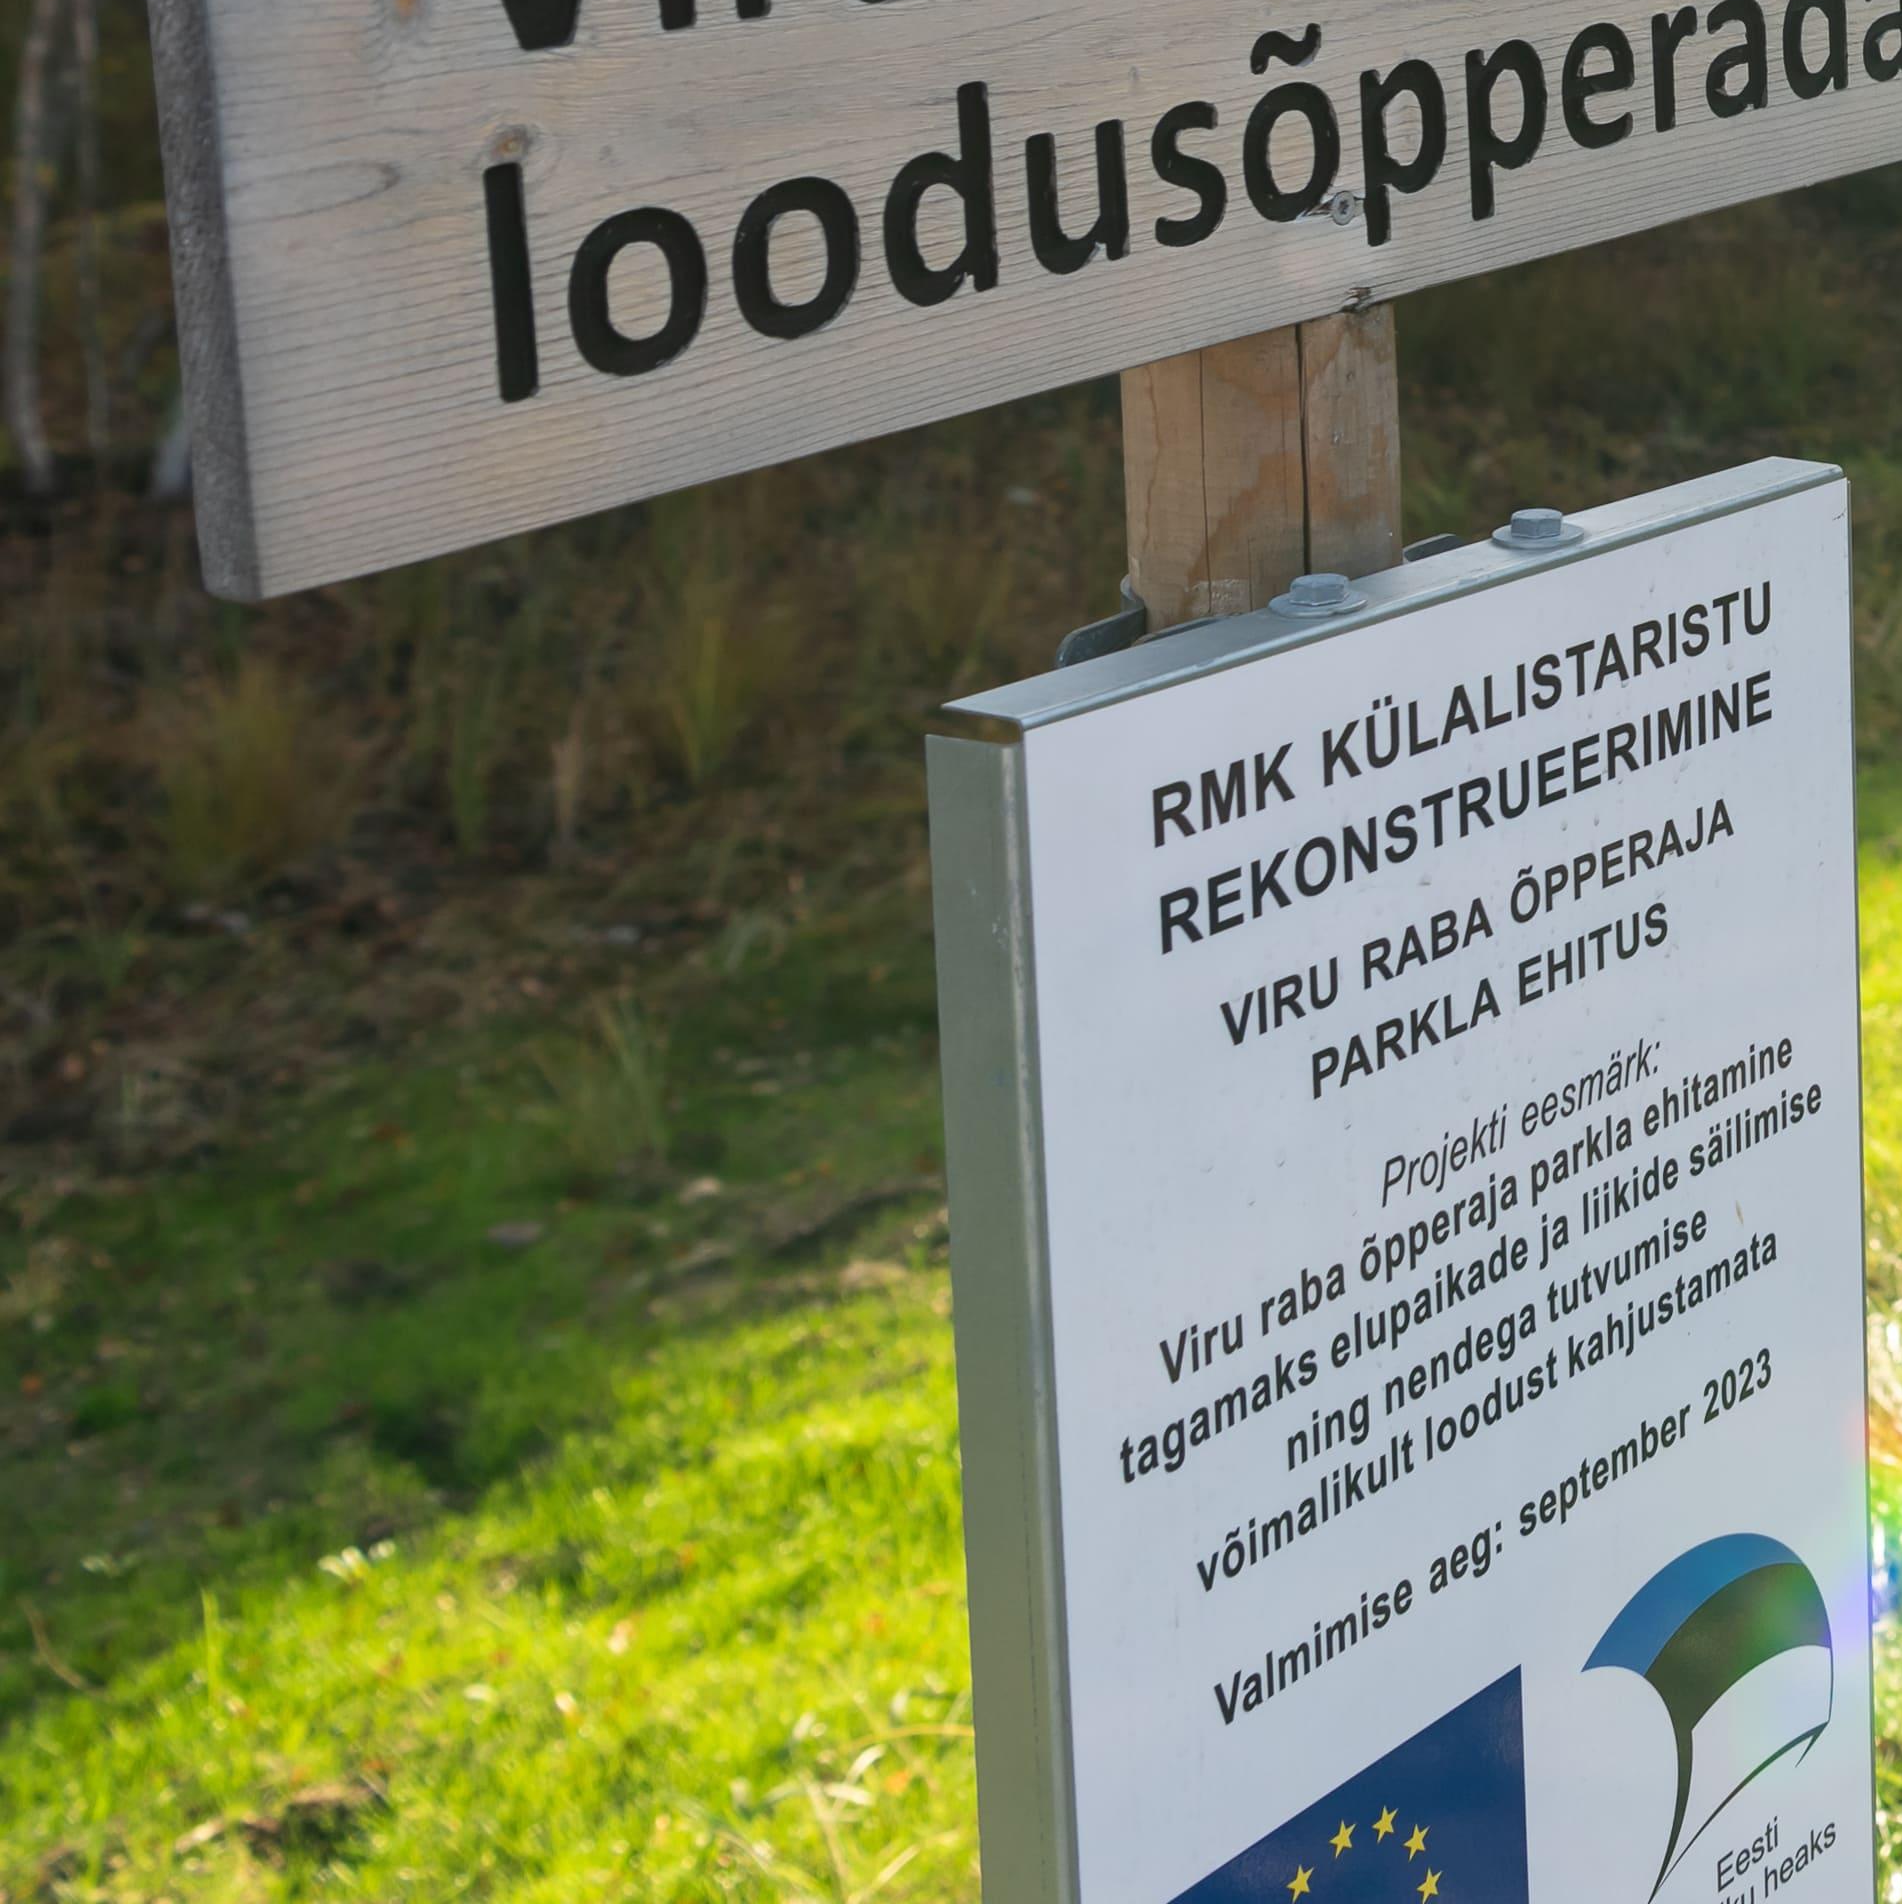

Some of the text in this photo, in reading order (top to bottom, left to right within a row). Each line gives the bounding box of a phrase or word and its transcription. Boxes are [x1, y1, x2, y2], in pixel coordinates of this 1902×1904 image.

[1153, 581, 1770, 848] RMK KÜLALISTARISTU
[1160, 671, 1772, 954] REKONSTRUEERIMINE
[1220, 799, 1734, 1045] VIRU RABA ÕPPERAJA
[1312, 903, 1667, 1099] PARKLA EHITUS
[1160, 1038, 1792, 1383] Viru raba õpperaja parkla ehitamine
[1382, 1039, 1659, 1207] Projekti eesmärk:
[1120, 1084, 1821, 1483] tagamaks elupaikade ja liikide säilimise
[1197, 1233, 1776, 1592] võimalikult loodust kahjustamata
[1288, 1211, 1706, 1470] ning nendega tutvumise
[1214, 1348, 1771, 1725] Valmimise aeg: september 2023
[1718, 1816, 1777, 1892] Eesti
[1765, 1823, 1835, 1898] heaks
